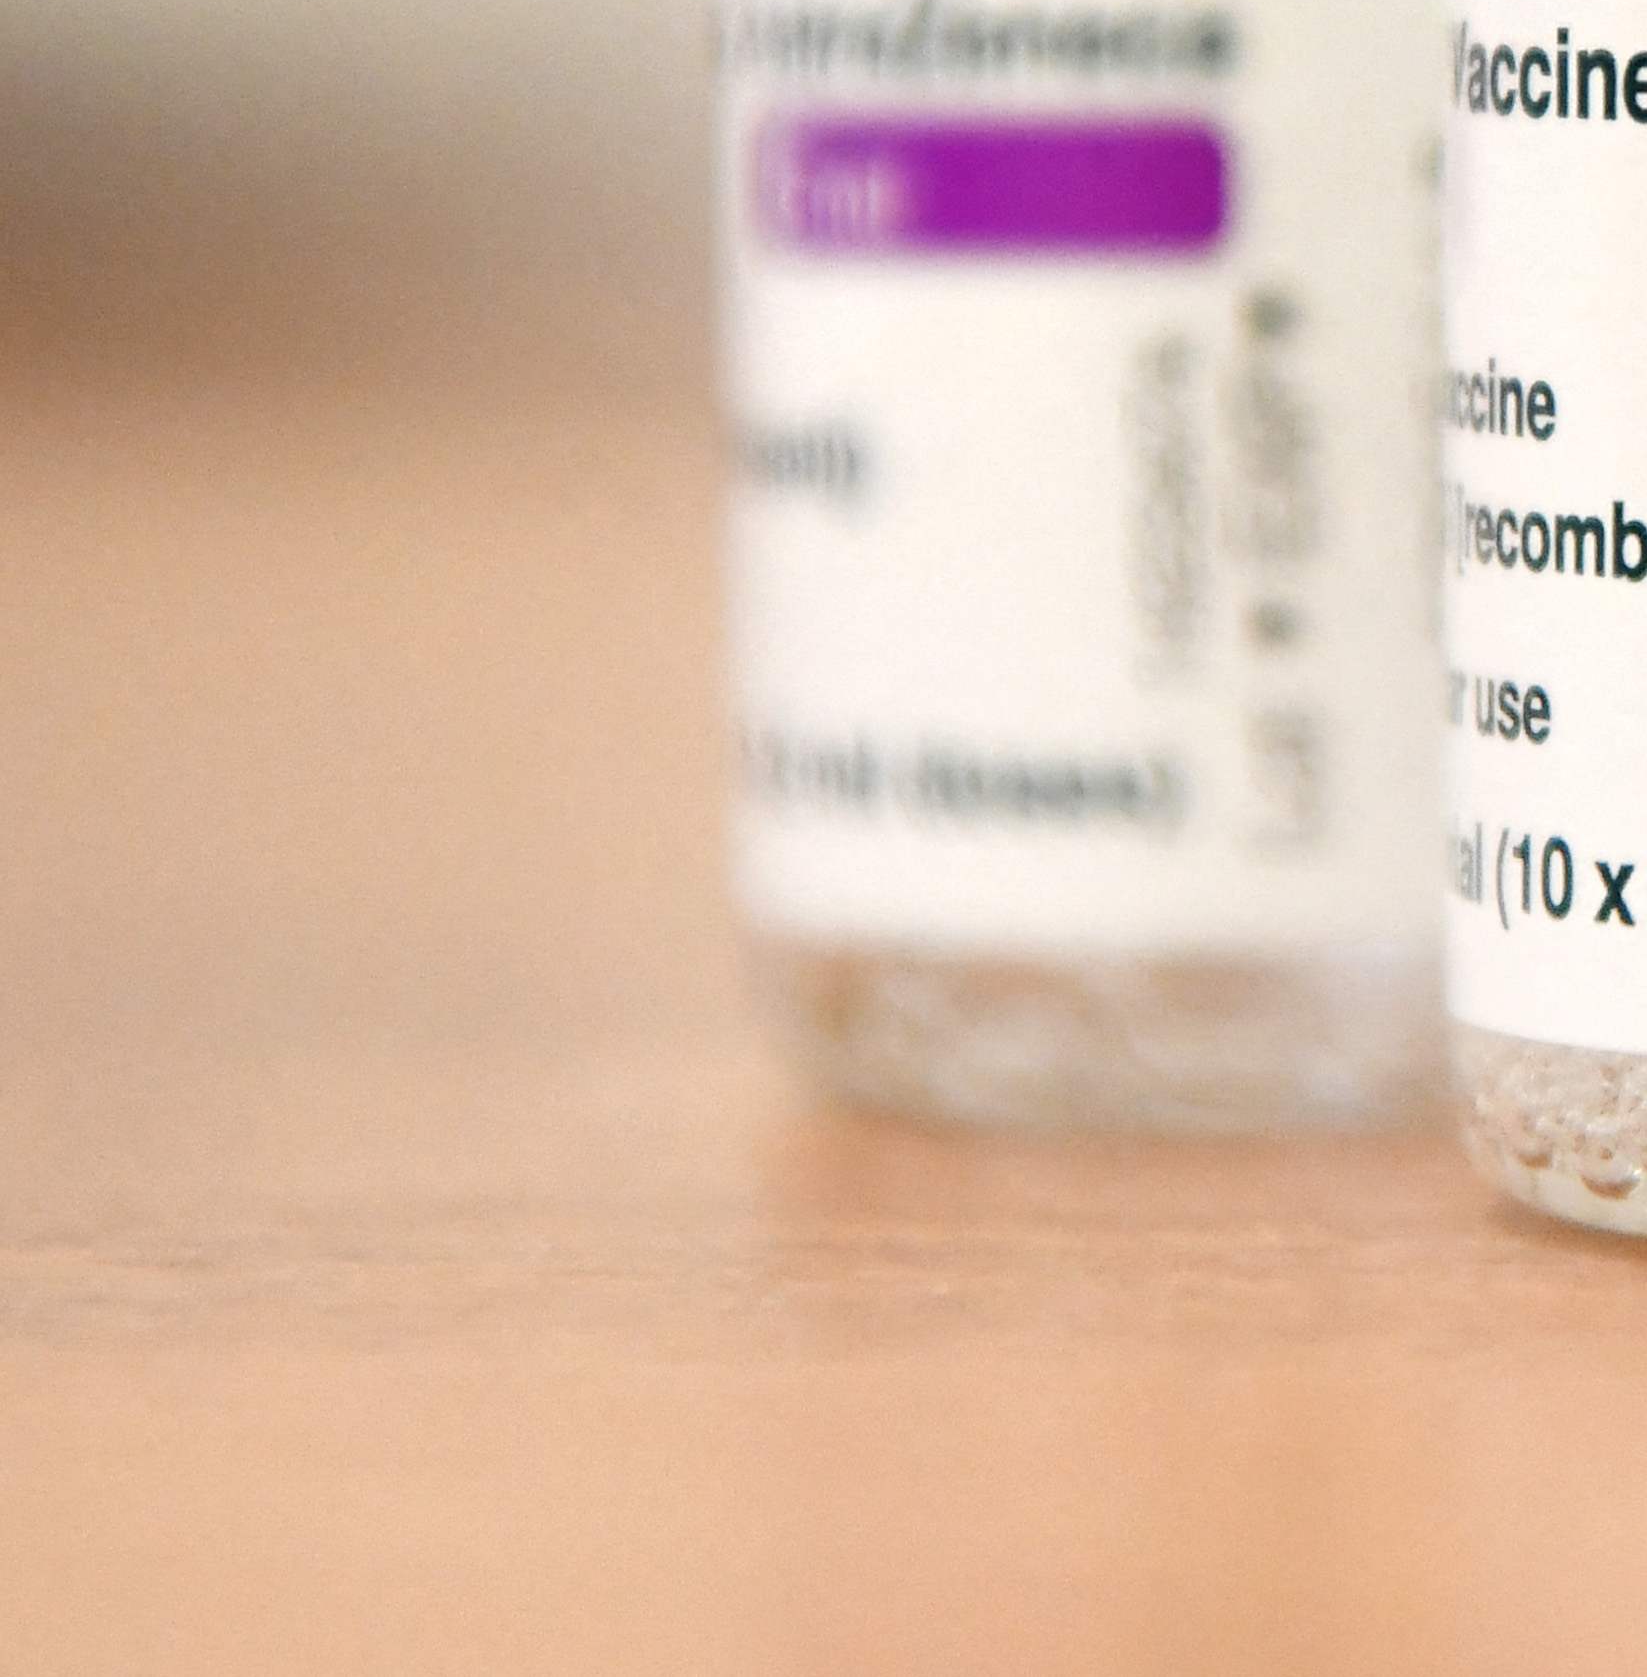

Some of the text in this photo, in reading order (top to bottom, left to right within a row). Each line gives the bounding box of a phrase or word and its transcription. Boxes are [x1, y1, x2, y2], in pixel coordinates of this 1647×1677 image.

[1475, 676, 1552, 745] use
[1496, 827, 1575, 930] (10
[1594, 860, 1636, 927] x
